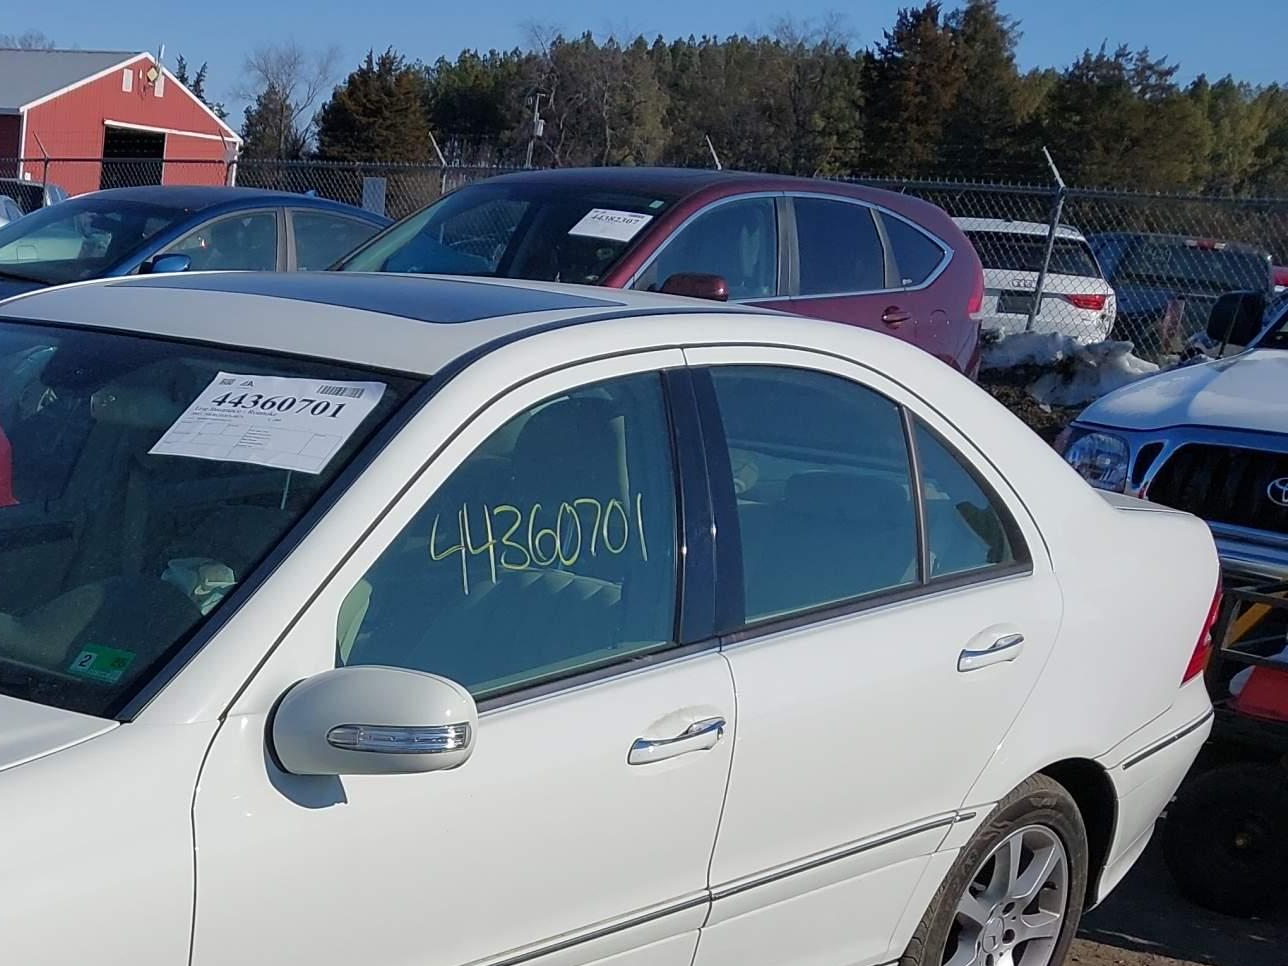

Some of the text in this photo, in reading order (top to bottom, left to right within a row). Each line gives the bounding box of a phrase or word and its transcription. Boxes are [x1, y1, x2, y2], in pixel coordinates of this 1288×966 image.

[212, 391, 347, 419] 44360701
[429, 492, 648, 596] 44360701
[78, 654, 92, 668] 2
